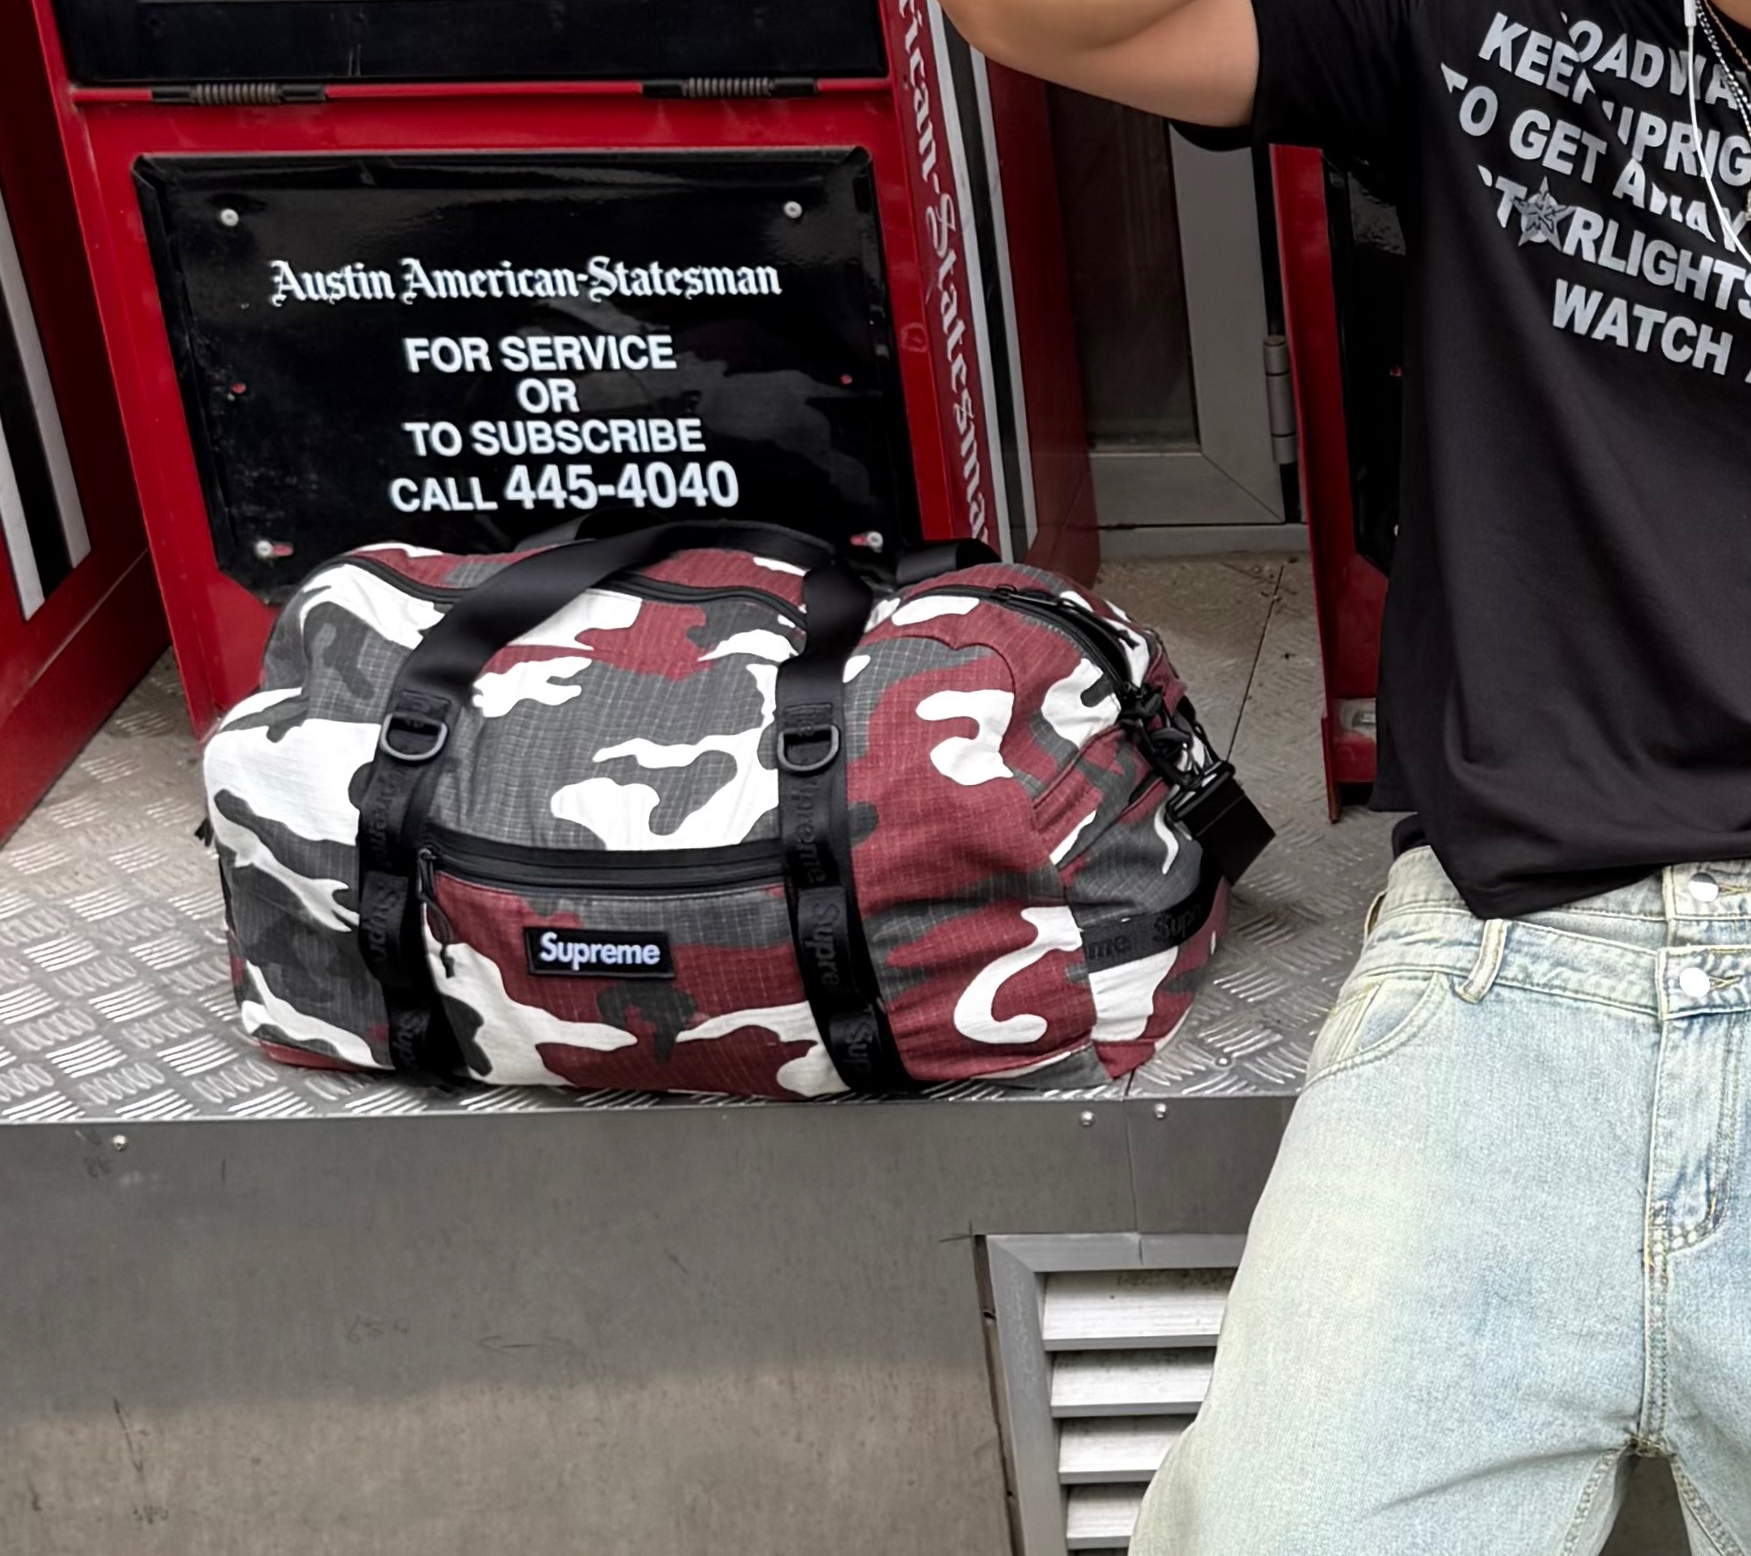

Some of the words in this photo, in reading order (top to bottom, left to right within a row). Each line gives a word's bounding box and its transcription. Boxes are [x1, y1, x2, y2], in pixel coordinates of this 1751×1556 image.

[1510, 109, 1607, 184] GET
[269, 260, 395, 306] Austin
[401, 255, 783, 305] American-Statesman
[1552, 278, 1733, 374] WATCH
[406, 336, 491, 372] FOR
[501, 334, 677, 370] SERVICE
[517, 379, 580, 414] OR
[406, 421, 463, 458] TO
[471, 417, 706, 456] SUBSCRIBE
[389, 476, 498, 513] CALL
[504, 460, 739, 511] 445-4040
[540, 933, 661, 971] Supreme
